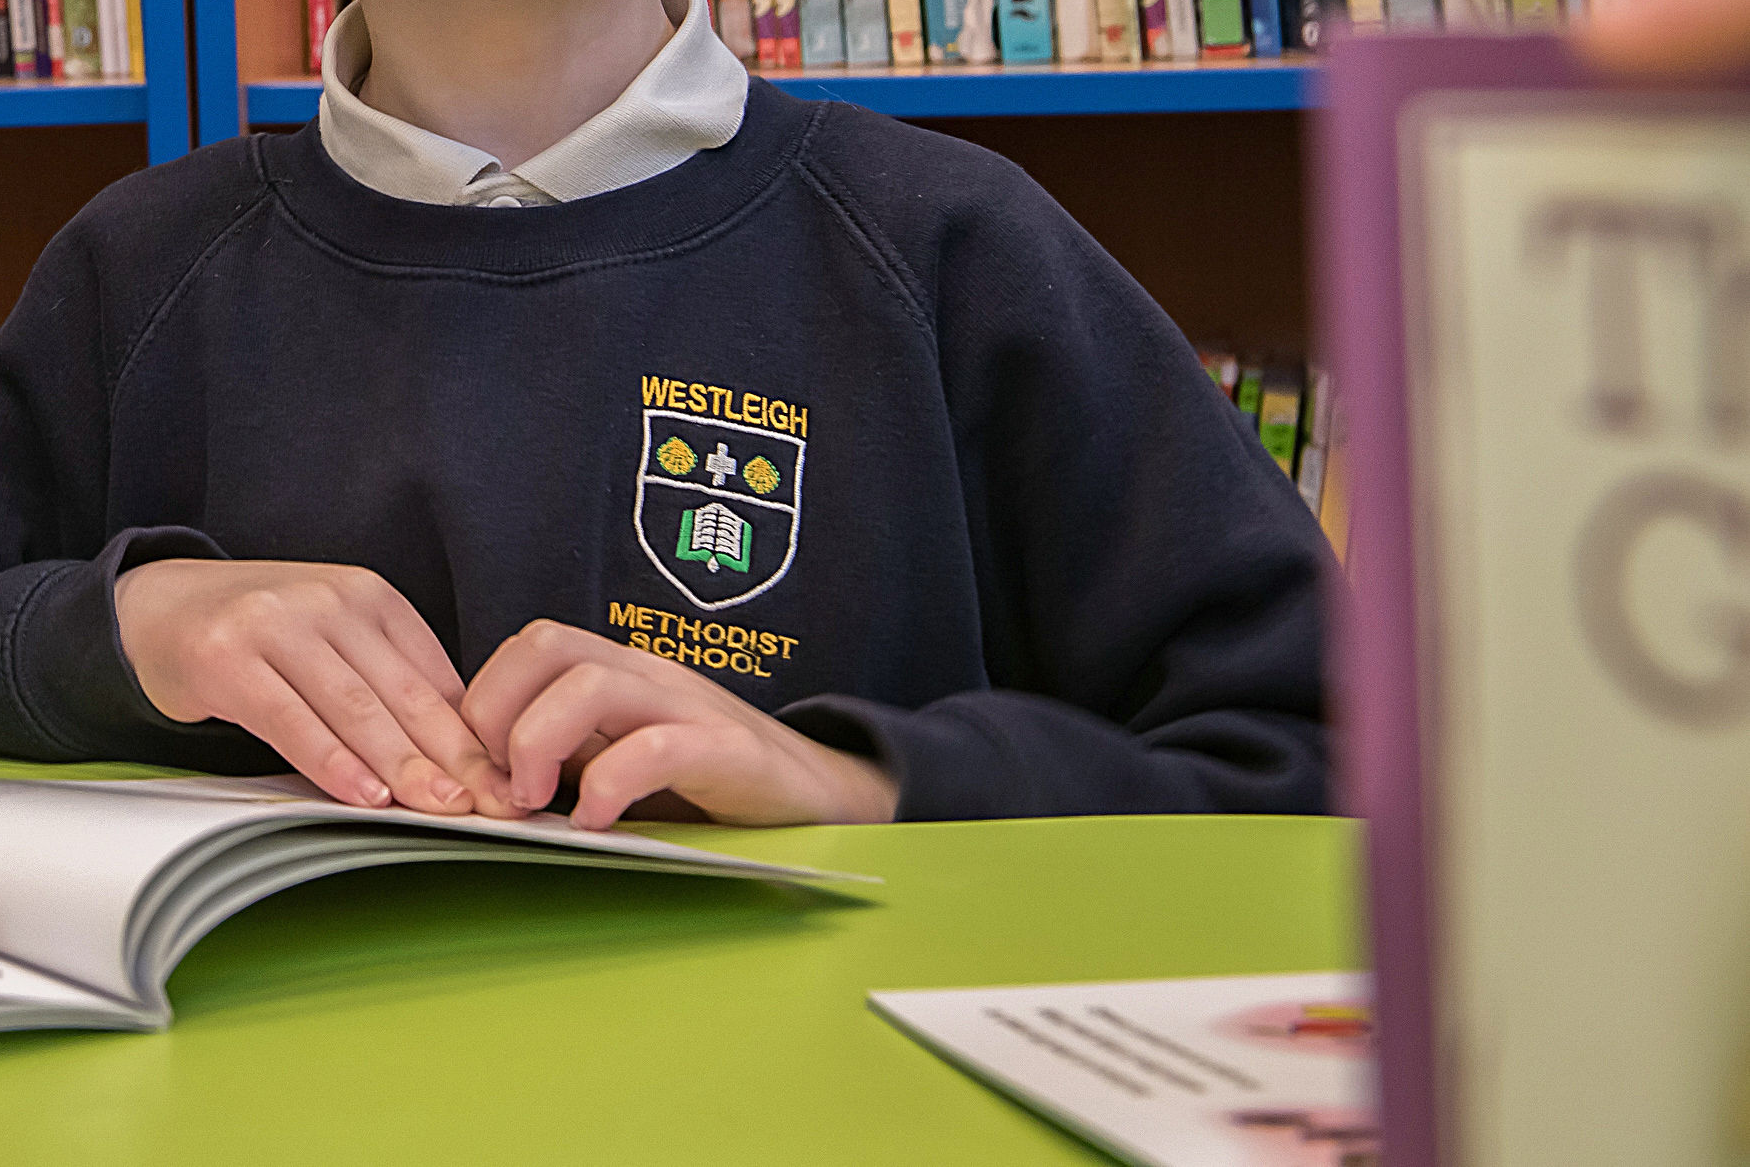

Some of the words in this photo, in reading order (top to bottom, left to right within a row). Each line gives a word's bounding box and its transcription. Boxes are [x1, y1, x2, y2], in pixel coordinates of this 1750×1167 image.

[641, 375, 808, 438] WESTLEIGH
[608, 601, 799, 660] METHODIST
[628, 631, 772, 678] SCHOOL
